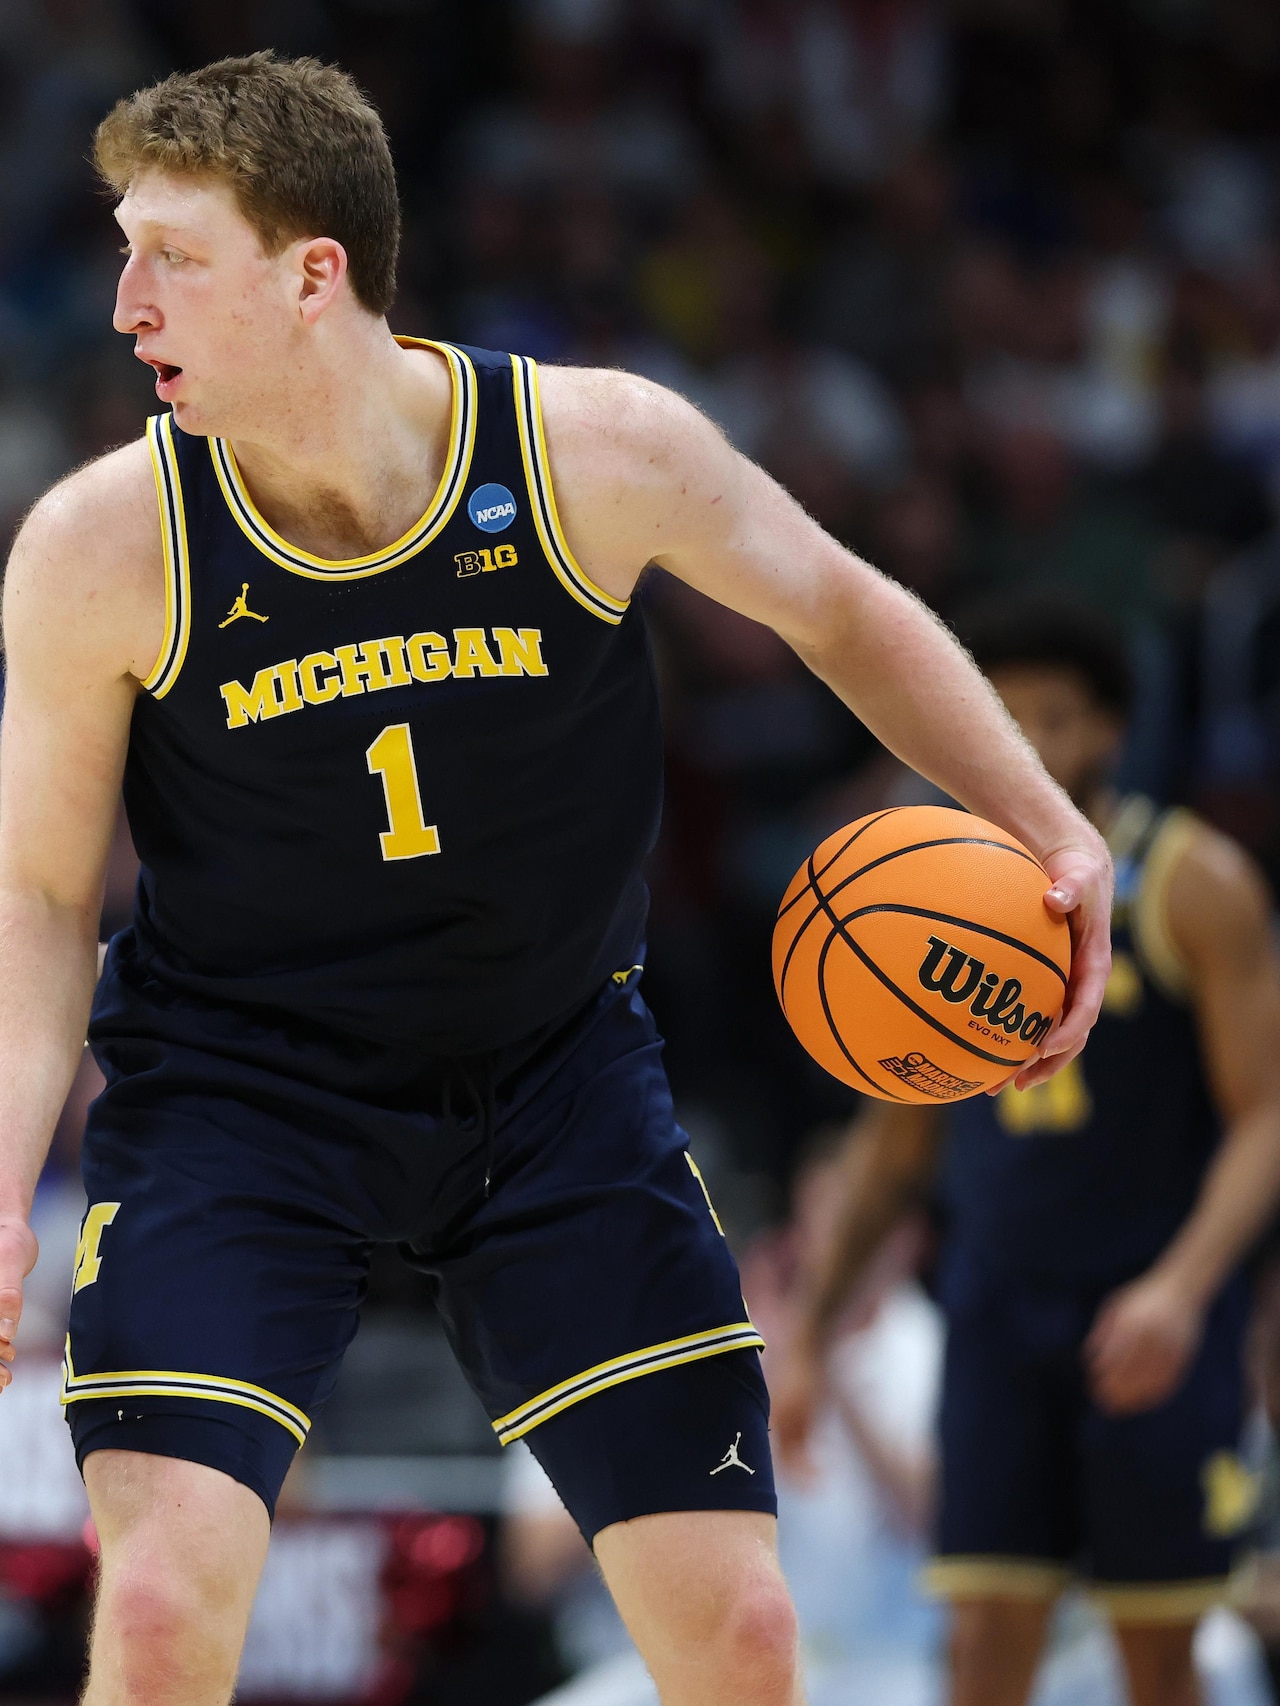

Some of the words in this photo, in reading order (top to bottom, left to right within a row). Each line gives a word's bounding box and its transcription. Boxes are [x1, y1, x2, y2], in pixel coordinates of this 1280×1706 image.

[476, 502, 515, 524] NCAA
[220, 627, 549, 729] MICHIGAN
[365, 722, 441, 861] 1
[918, 934, 1054, 1047] Wilson
[967, 1019, 991, 1036] EVO
[990, 1033, 1012, 1046] NXT
